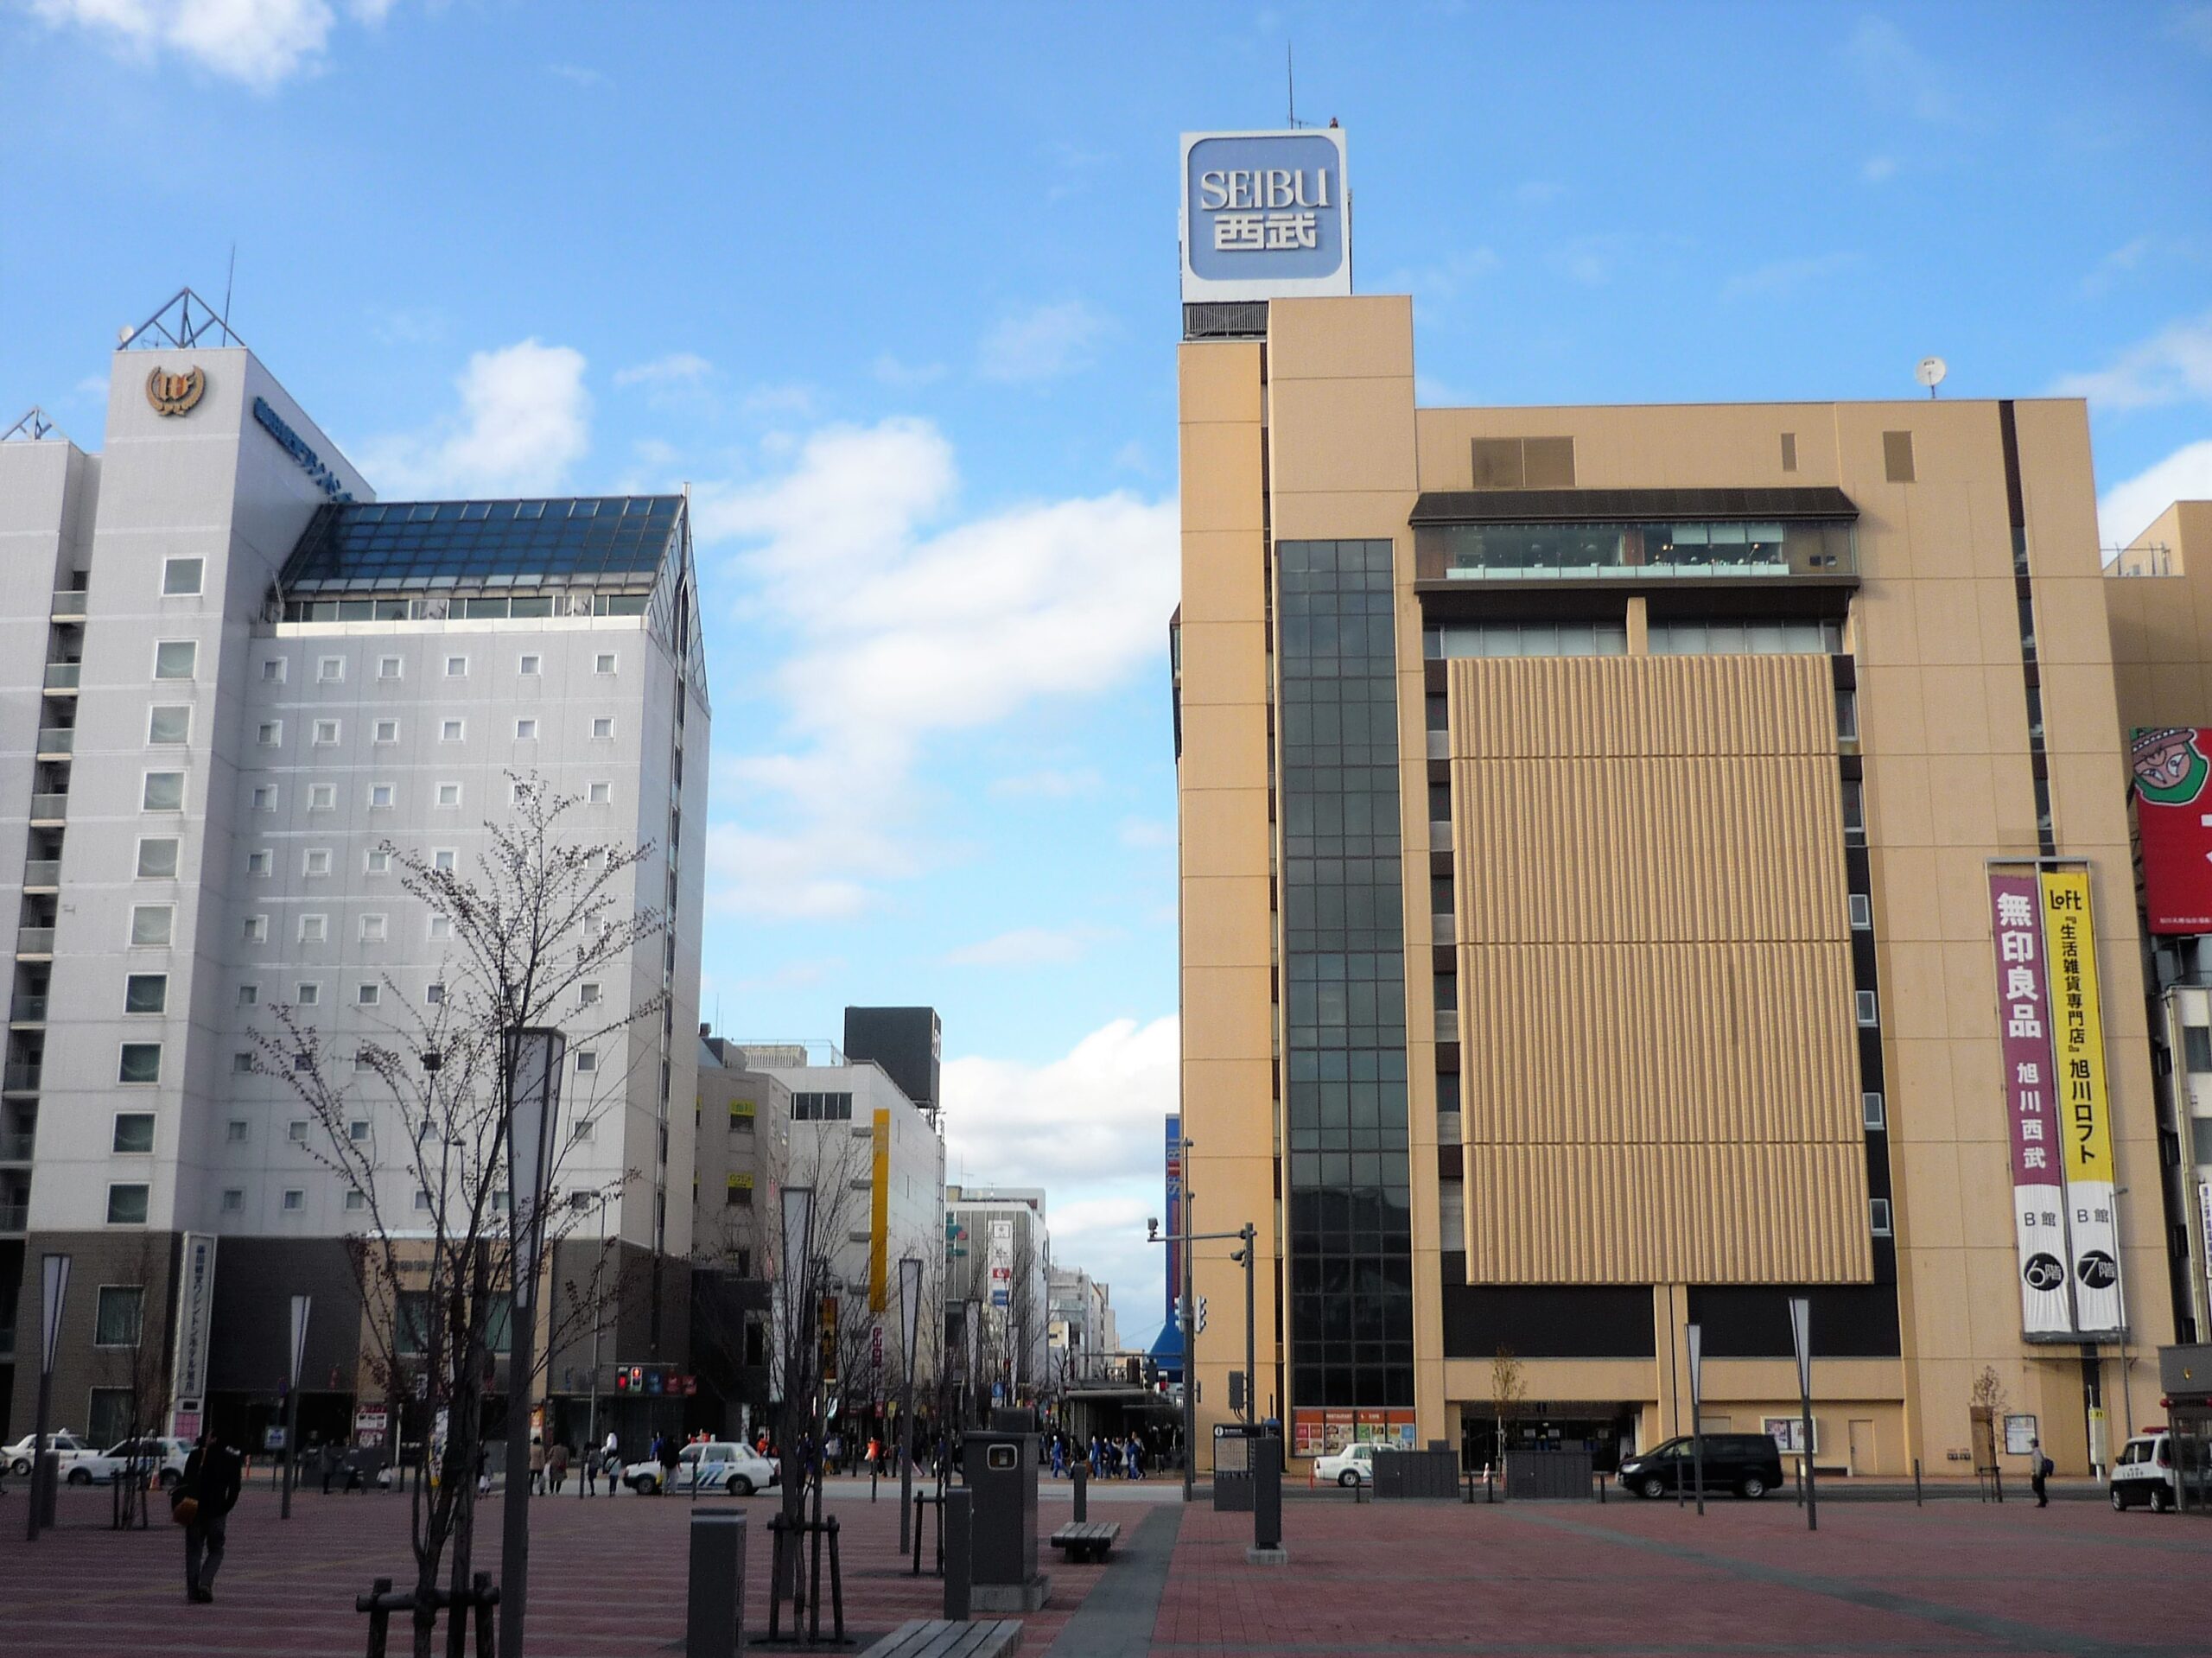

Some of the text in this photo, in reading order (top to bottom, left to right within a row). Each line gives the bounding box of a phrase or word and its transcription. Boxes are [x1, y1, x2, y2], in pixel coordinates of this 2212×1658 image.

[1201, 168, 1332, 210] SEIBU
[1214, 212, 1316, 251] 西武
[1997, 892, 2046, 1169] 無印良品 旭川西武
[2026, 1260, 2062, 1286] 6階
[2080, 1257, 2115, 1284] 7階
